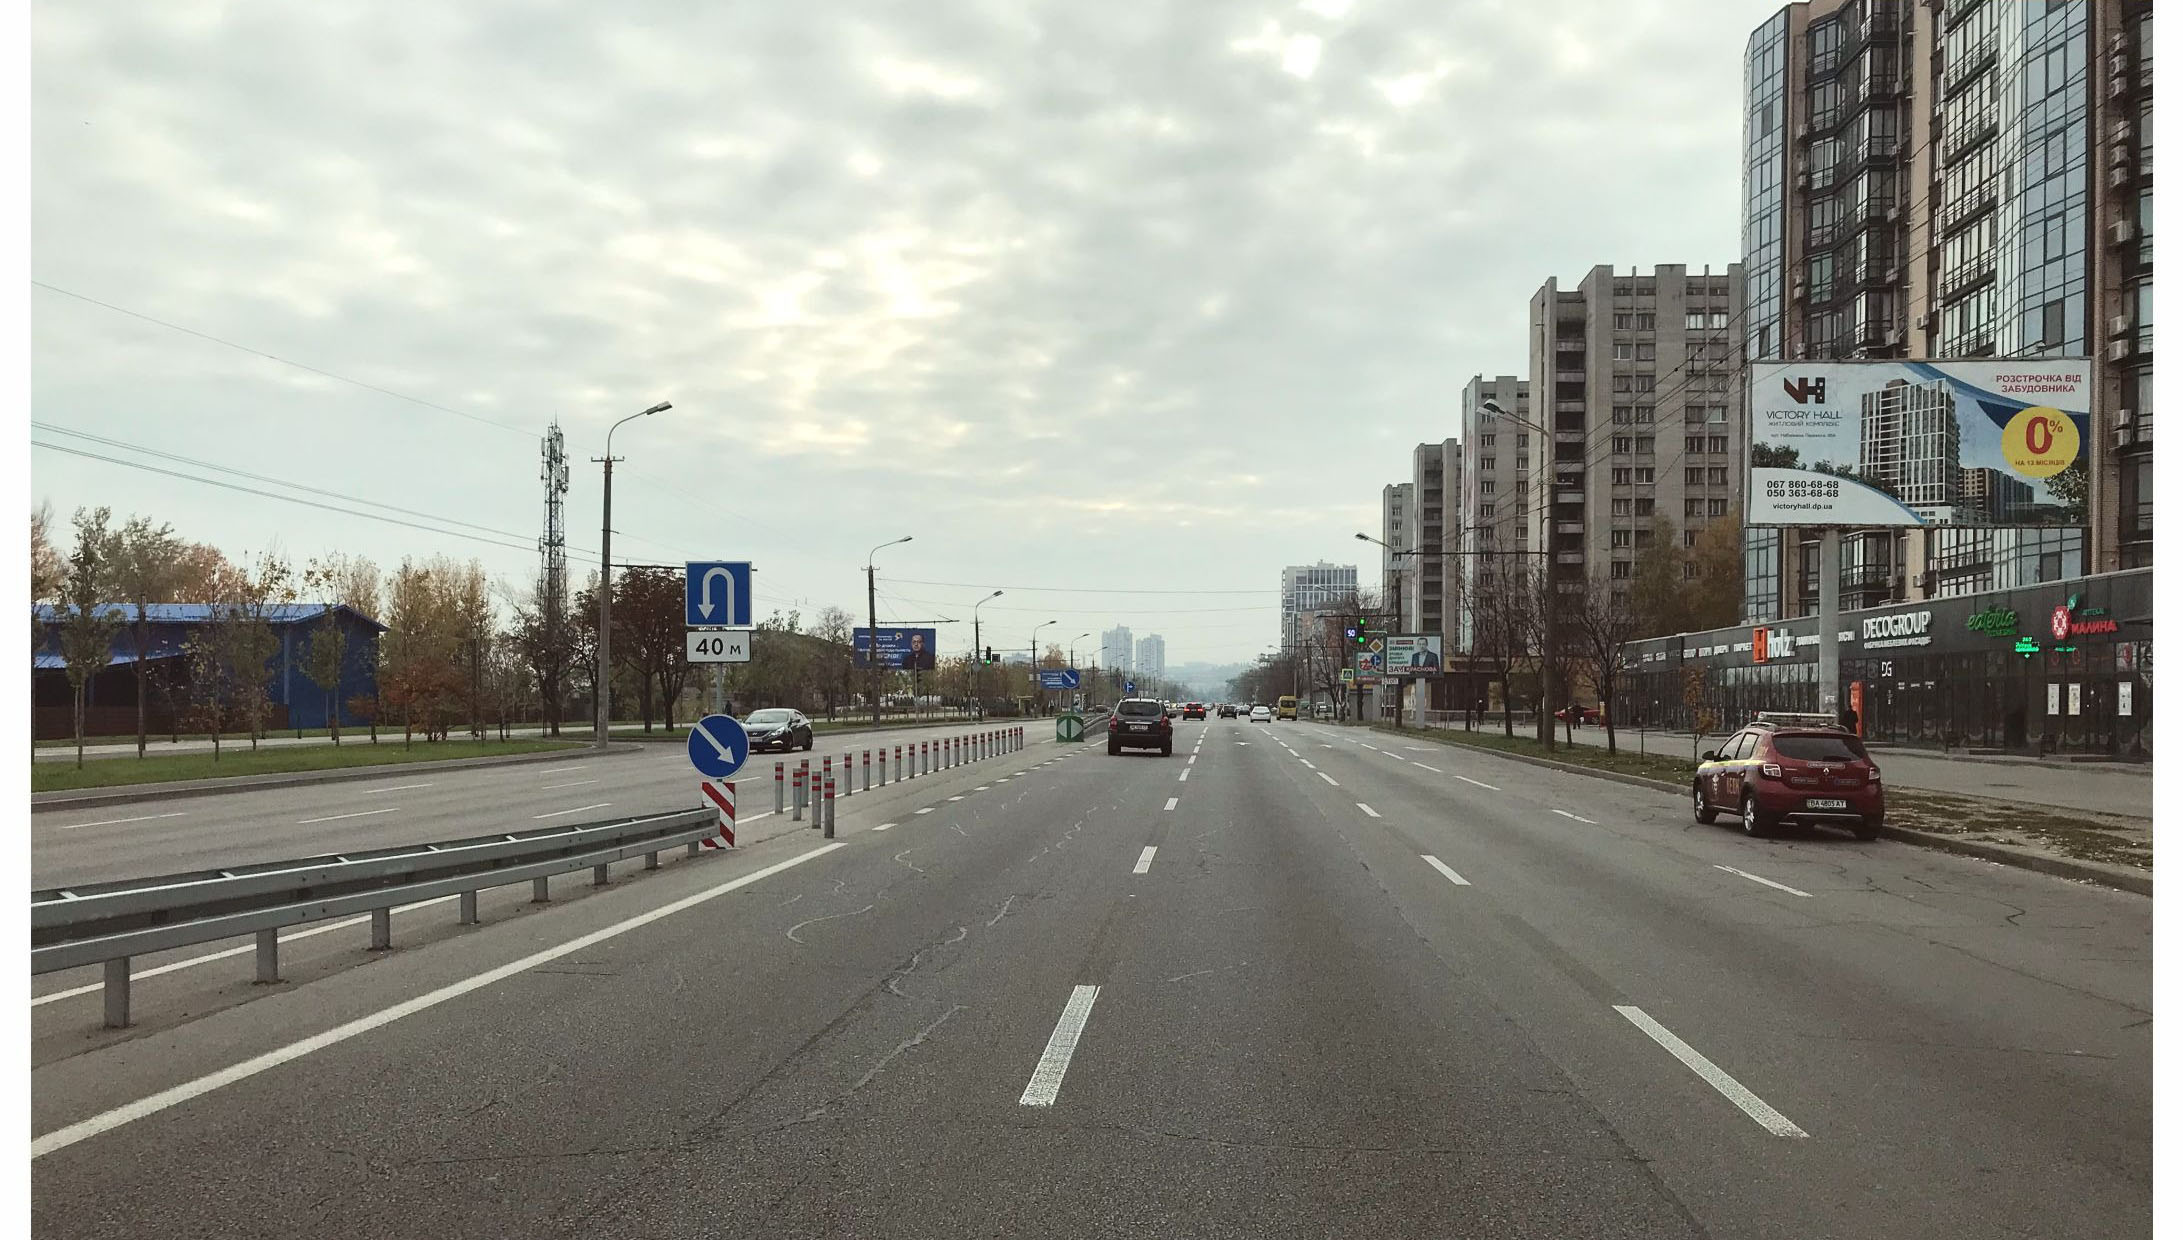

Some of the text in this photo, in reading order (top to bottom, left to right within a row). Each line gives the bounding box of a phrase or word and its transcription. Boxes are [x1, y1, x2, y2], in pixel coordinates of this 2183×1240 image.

[1996, 374, 2082, 384] РОЗСТРОЧКА ВІД
[2002, 385, 2076, 394] ЗАБУДОВНИКА
[1766, 411, 1843, 420] VICTORY HALL
[1767, 480, 1839, 489] 067 860-68-68
[1767, 489, 1839, 498] 050 363-68-68
[1773, 503, 1833, 511] victoryhall.dp.ua
[1863, 611, 1932, 639] DECOGROUP
[2071, 619, 2118, 635] МАЛИНА
[696, 638, 724, 656] 40
